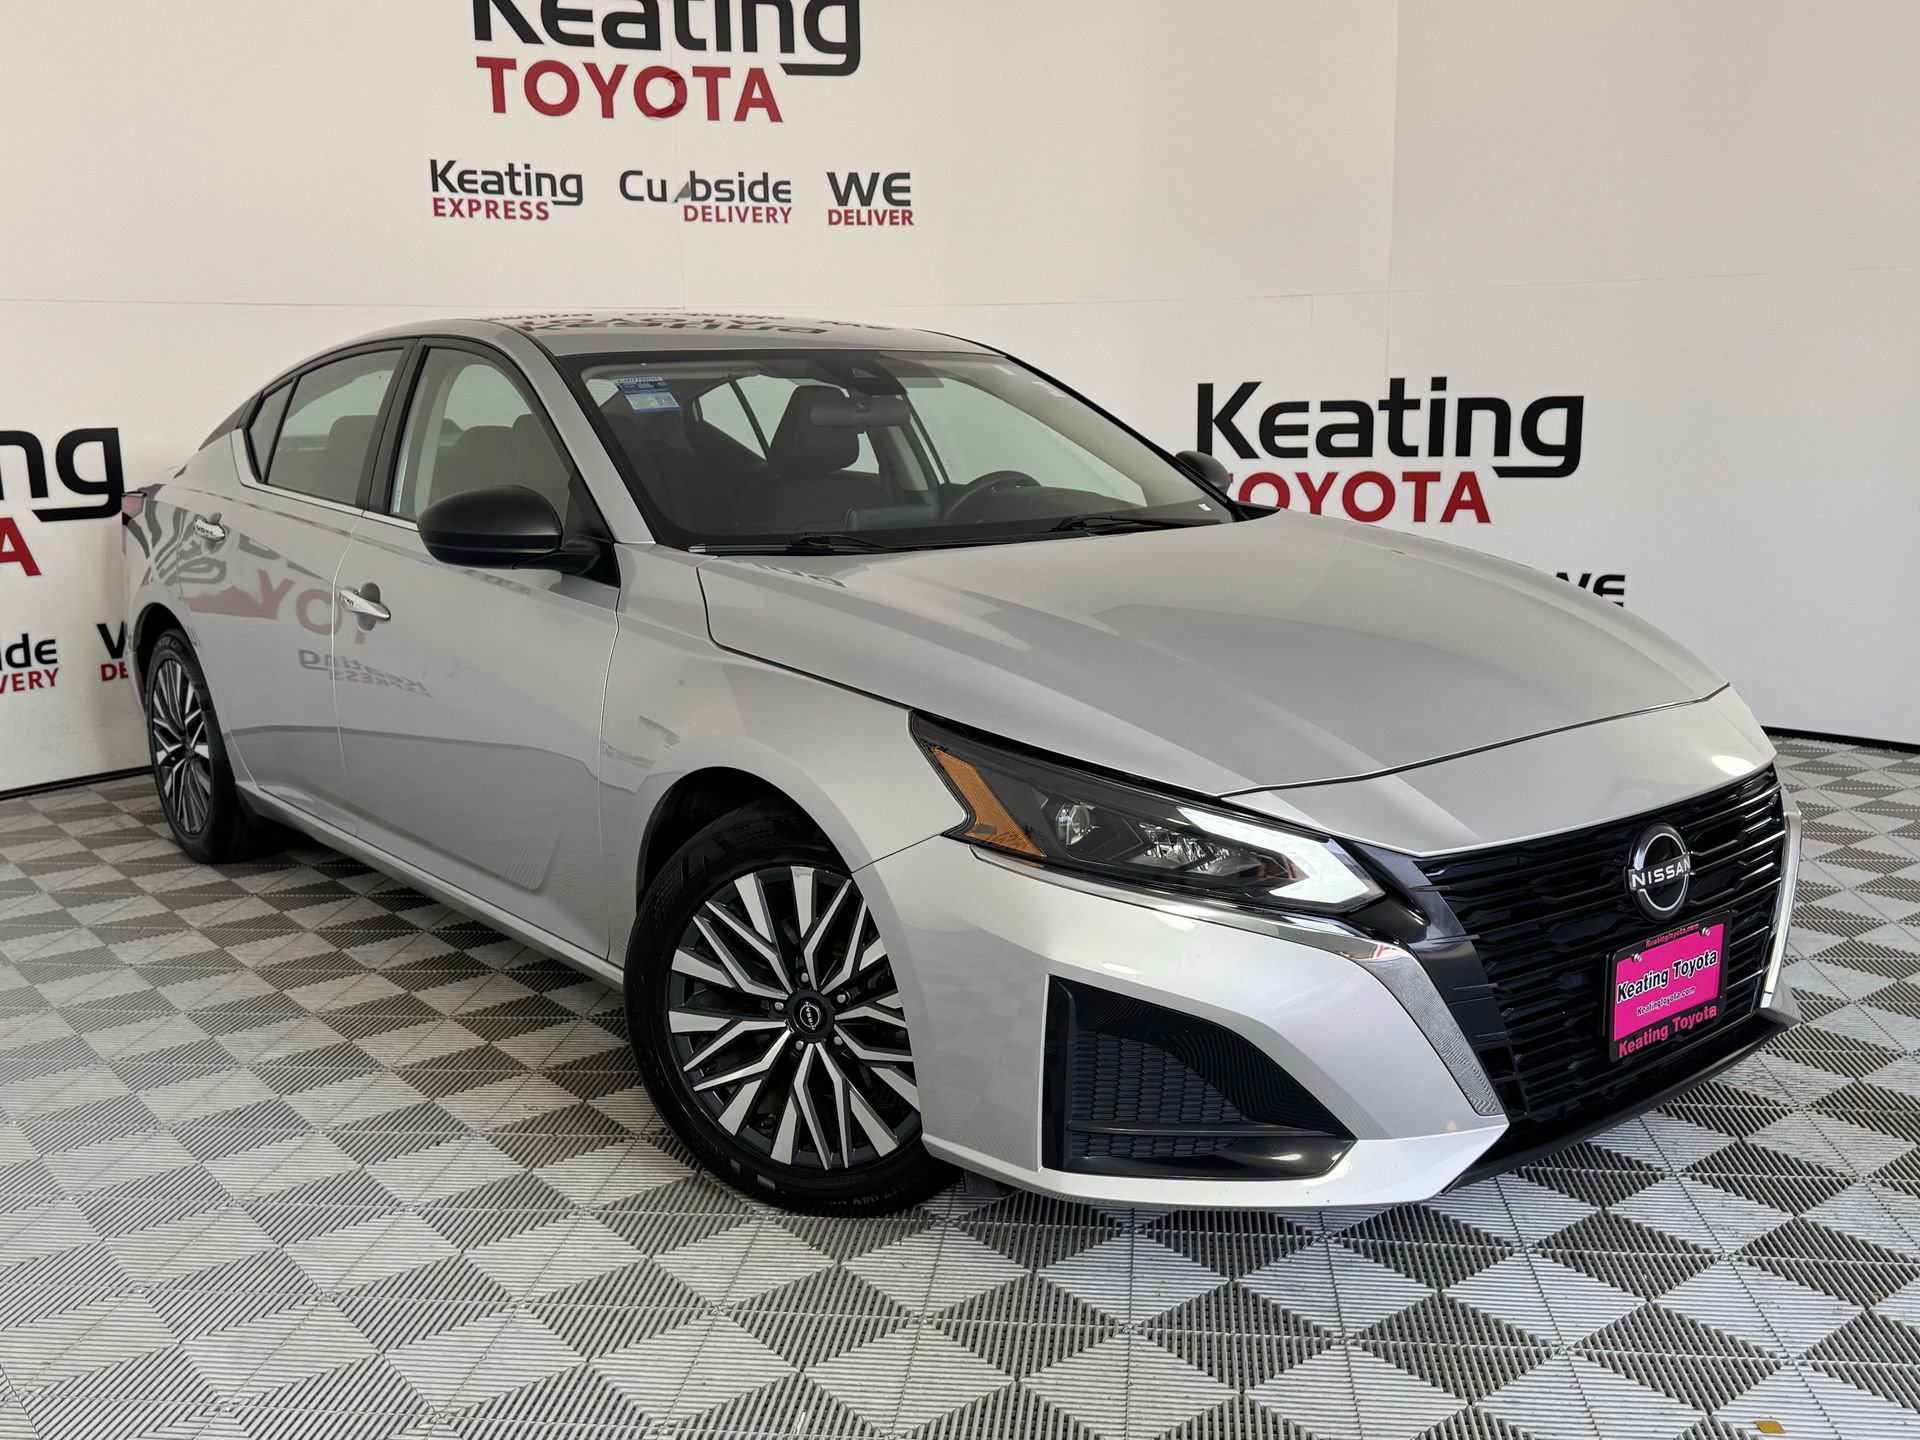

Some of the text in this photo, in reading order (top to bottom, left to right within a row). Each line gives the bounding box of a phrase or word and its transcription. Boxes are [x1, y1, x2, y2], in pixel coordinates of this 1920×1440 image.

[473, 0, 861, 76] Keating
[476, 56, 783, 122] TOYOTA
[430, 159, 583, 206] Keating
[619, 170, 792, 203] Cubside
[827, 172, 911, 207] WE
[433, 198, 550, 220] EXPRESS
[684, 205, 791, 223] DELIVERY
[828, 209, 914, 226] DELIVER
[1197, 376, 1585, 478] Keating
[0, 427, 125, 522] ng
[1229, 471, 1492, 523] OYOTA
[0, 633, 58, 671] de
[1631, 854, 1691, 888] NISSAN
[1616, 950, 1718, 1003] Keating Toyota
[1618, 1005, 1717, 1058] Keating Toyota
